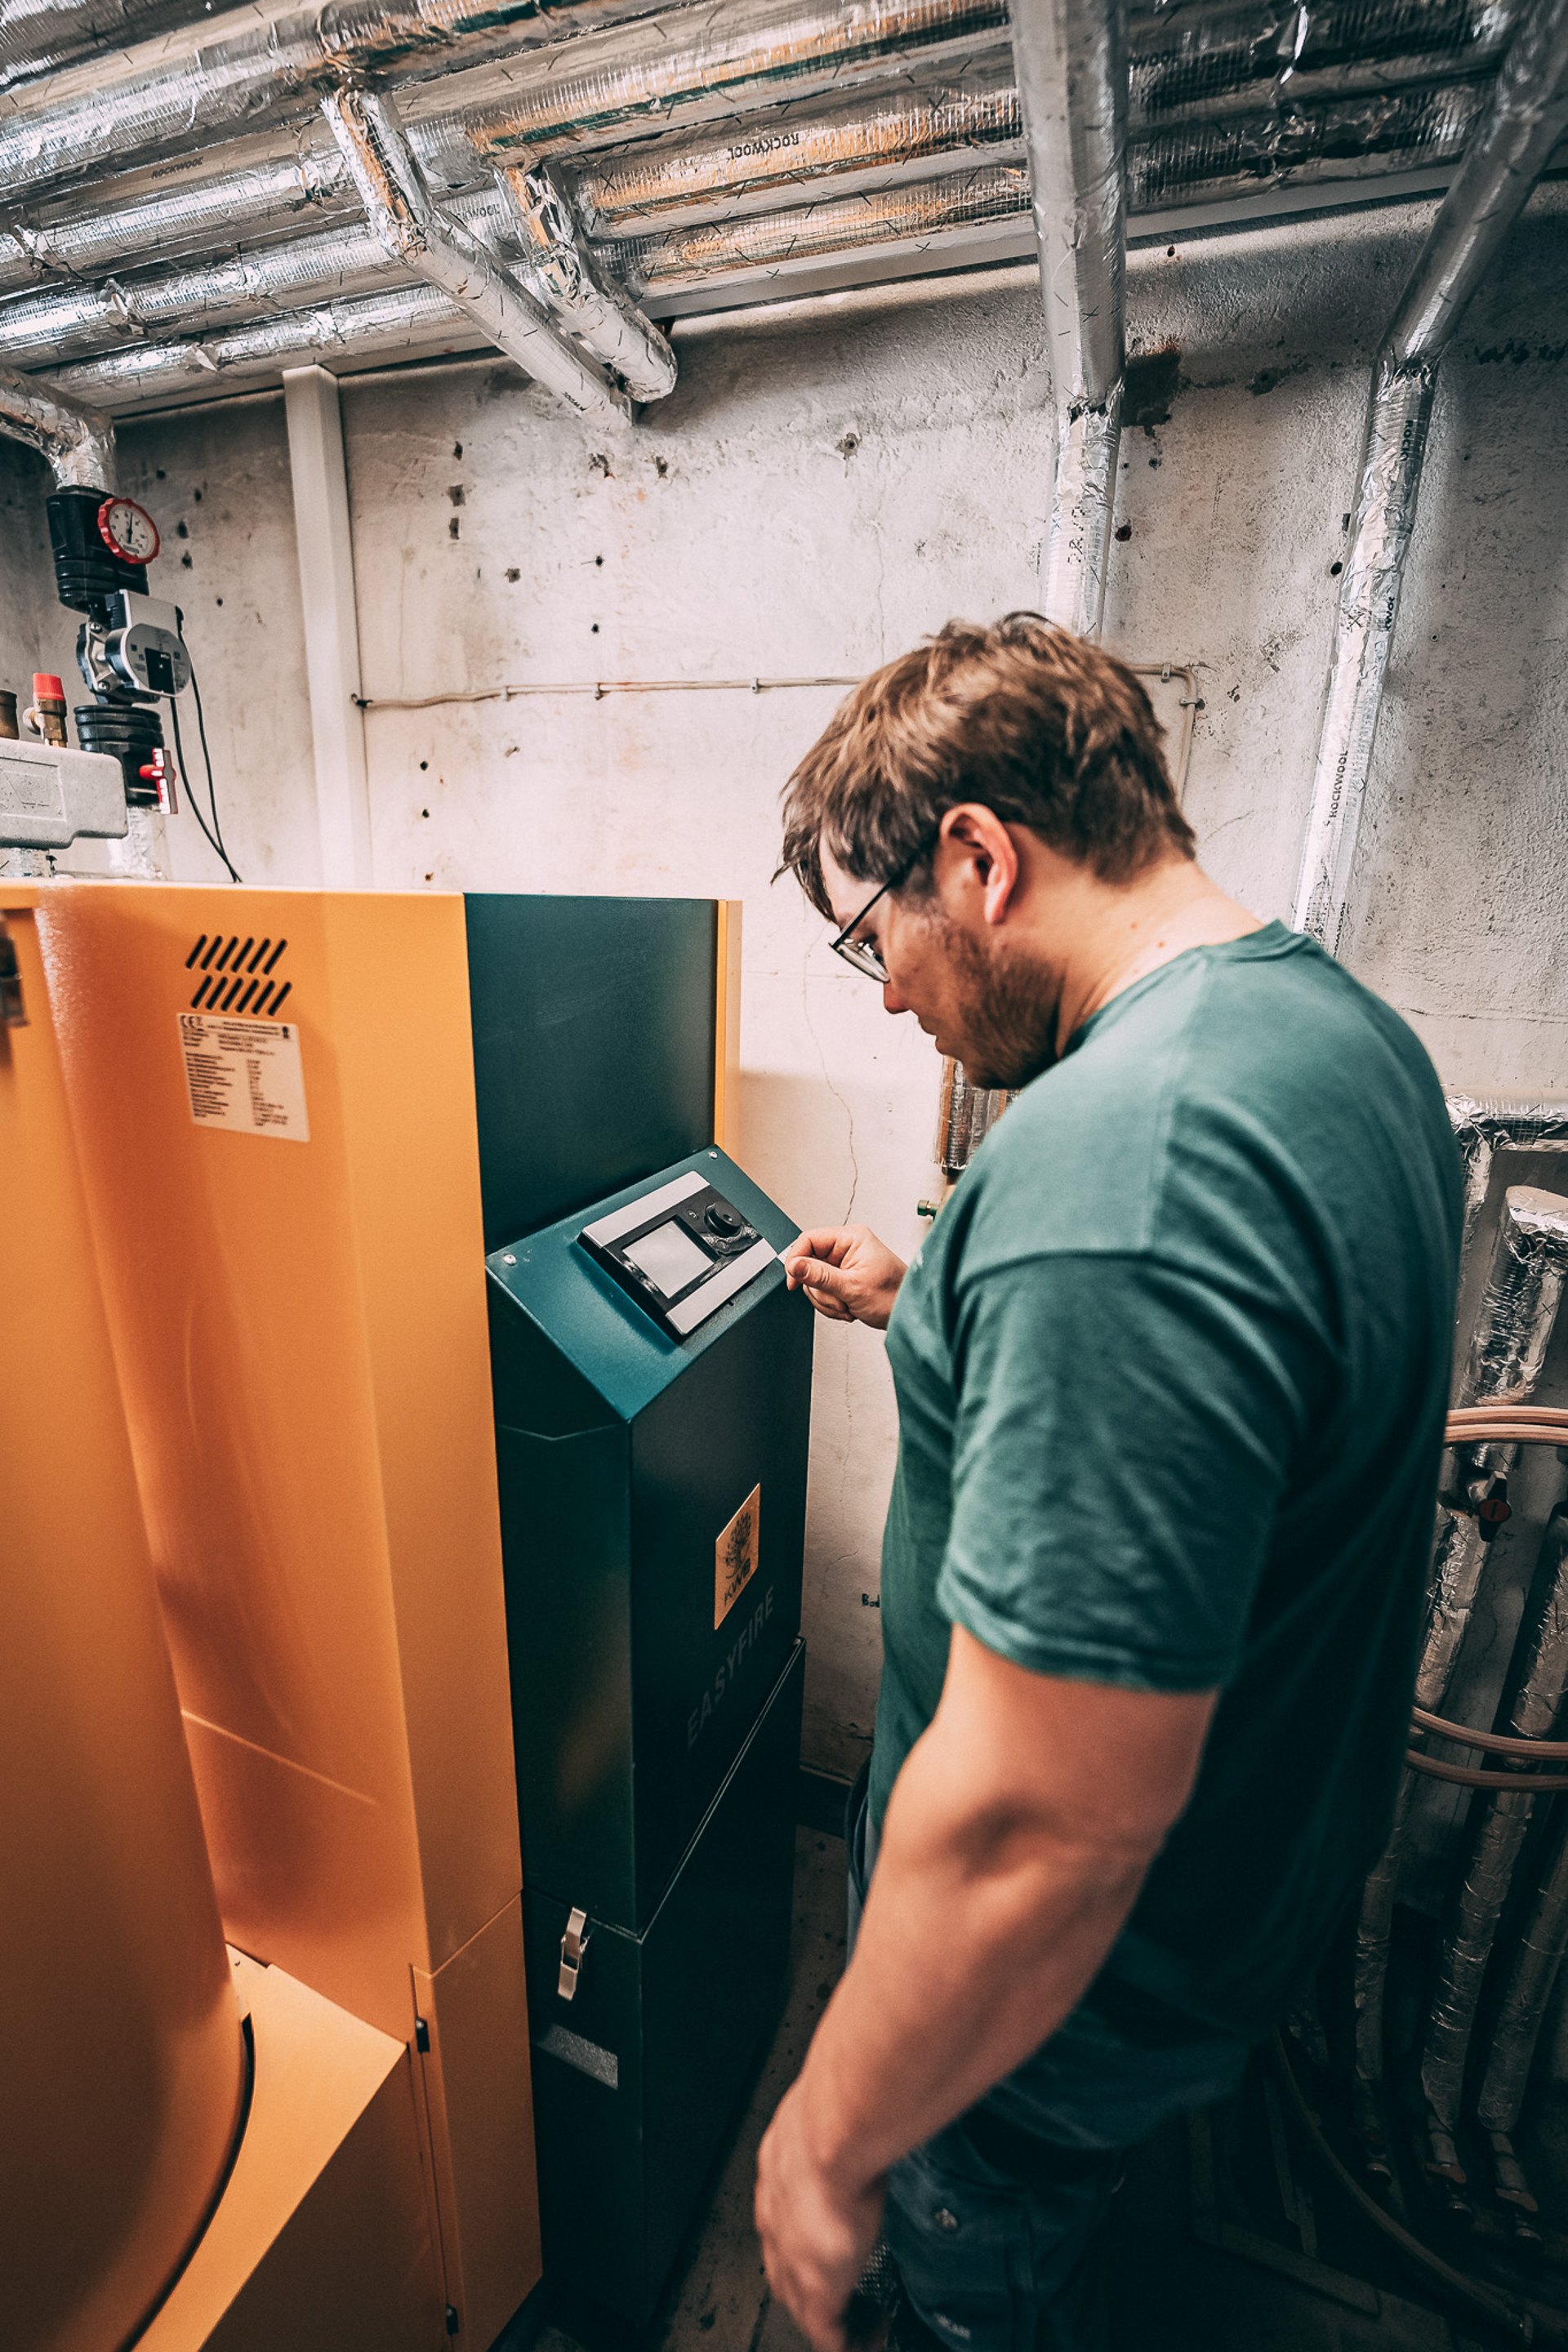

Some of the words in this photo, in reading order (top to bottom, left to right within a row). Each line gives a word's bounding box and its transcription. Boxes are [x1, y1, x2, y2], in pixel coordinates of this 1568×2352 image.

[728, 132, 799, 159] ROCKWOOL
[1329, 751, 1348, 818] ROCKWOOL
[724, 1557, 752, 1608] KWB
[687, 1584, 774, 1753] EASYFIRE
